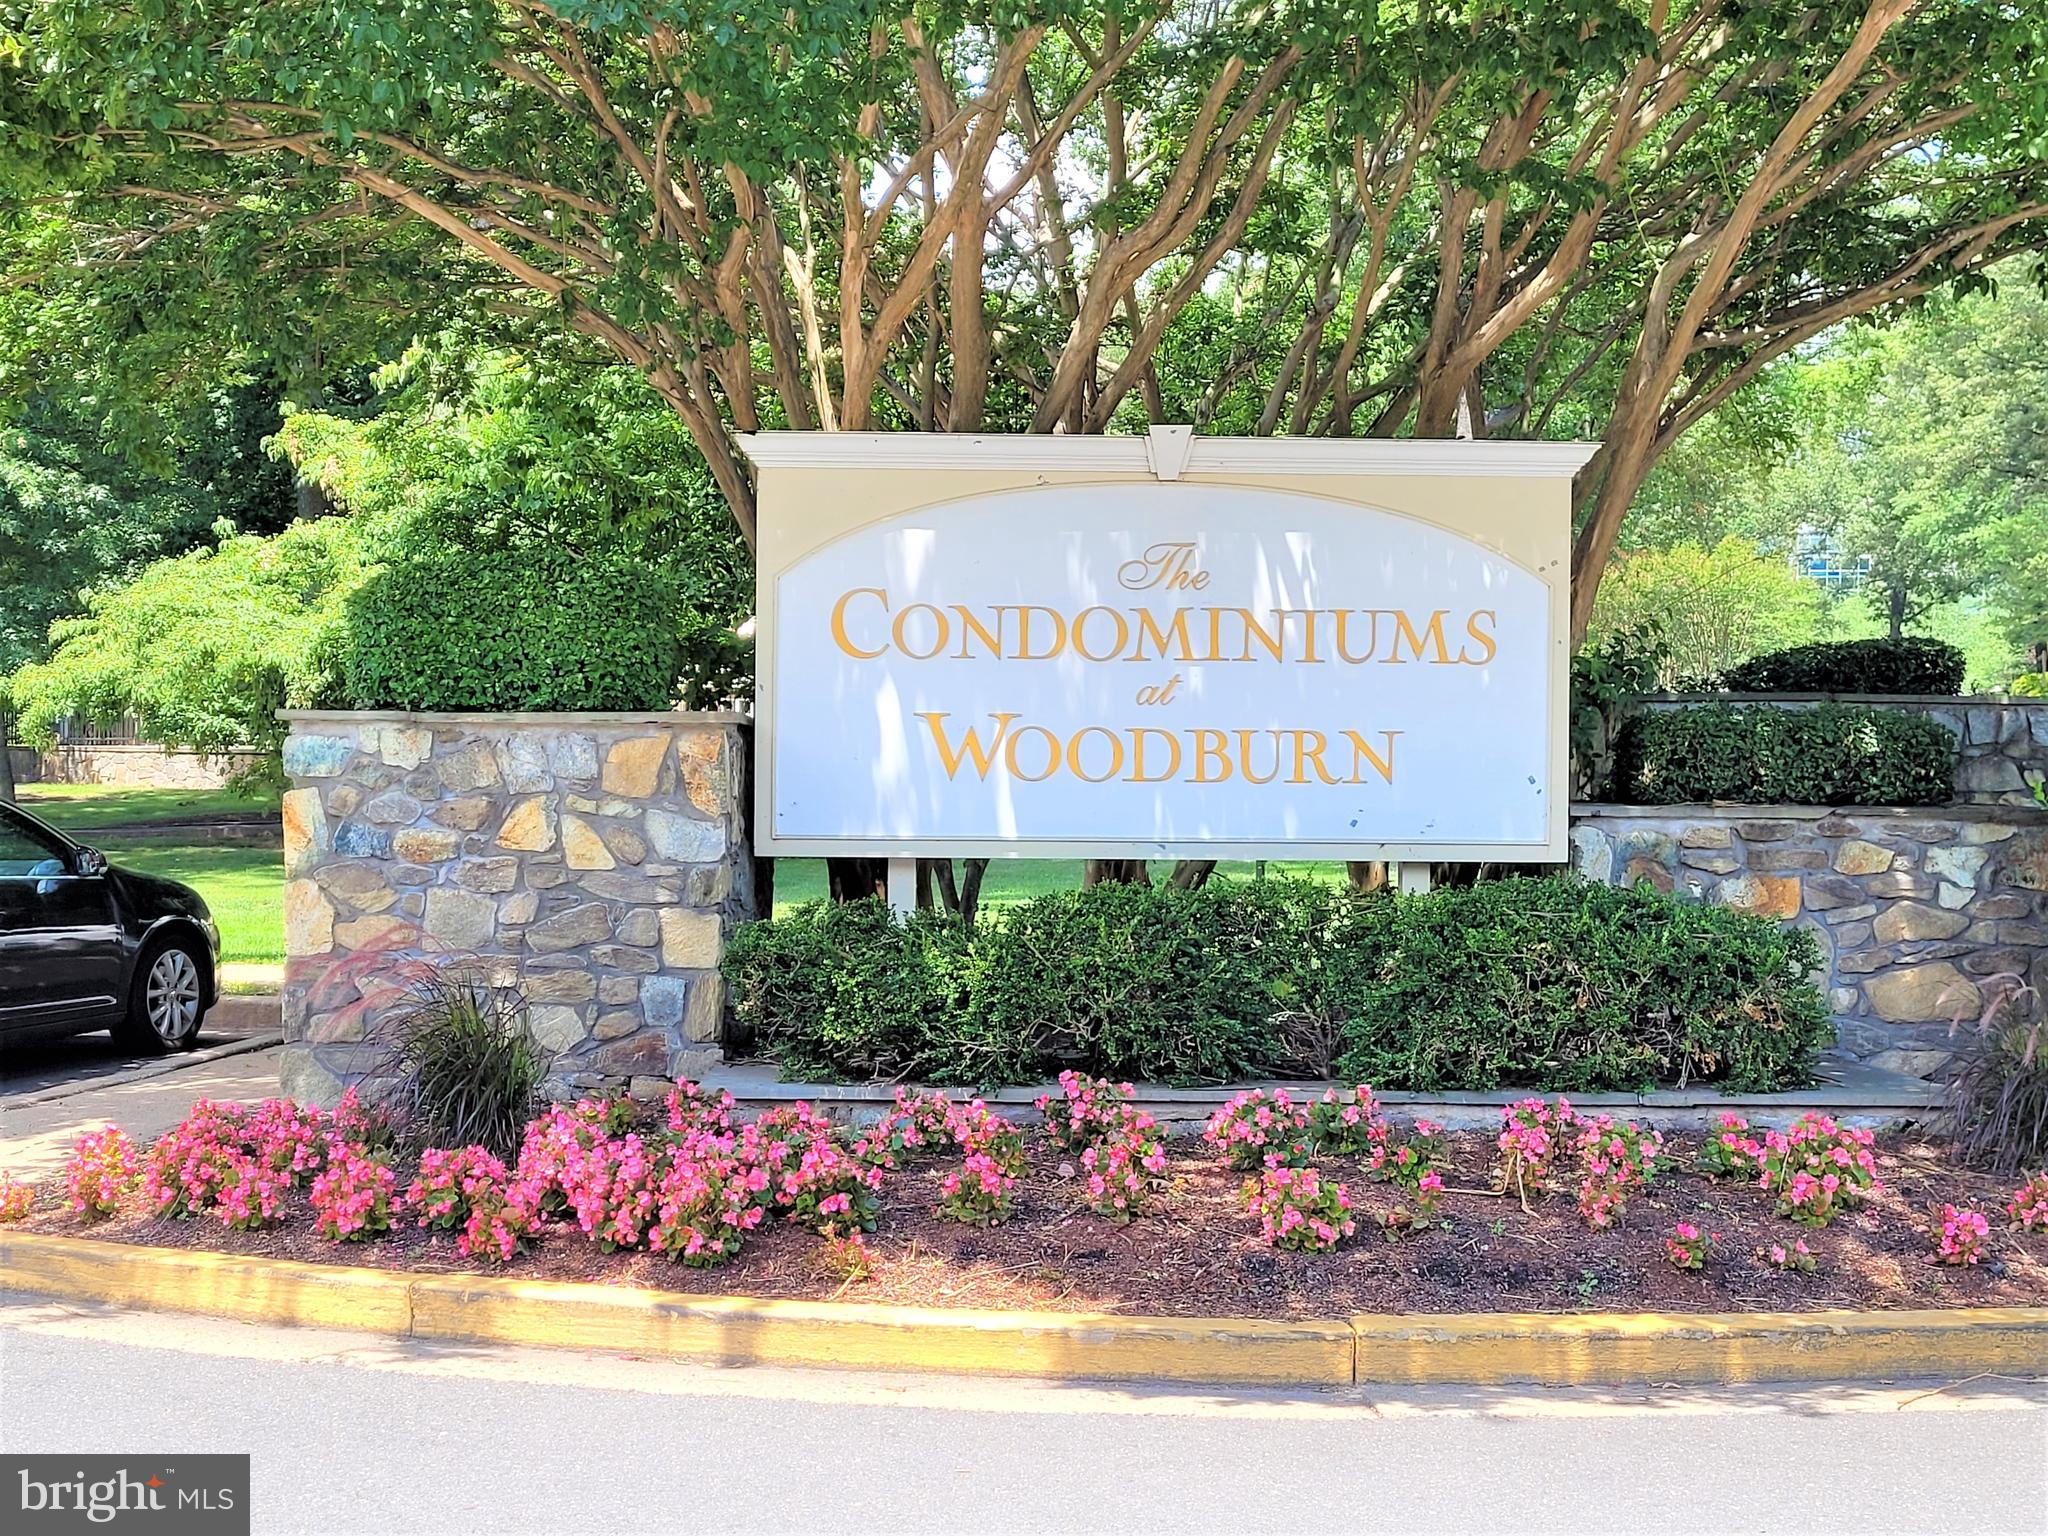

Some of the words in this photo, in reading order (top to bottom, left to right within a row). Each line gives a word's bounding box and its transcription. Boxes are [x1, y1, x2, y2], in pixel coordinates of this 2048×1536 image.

[1118, 542, 1211, 591] The
[830, 587, 1498, 666] CONDOMINIUMS
[1136, 673, 1183, 707] at
[913, 711, 1405, 785] WOODBURN
